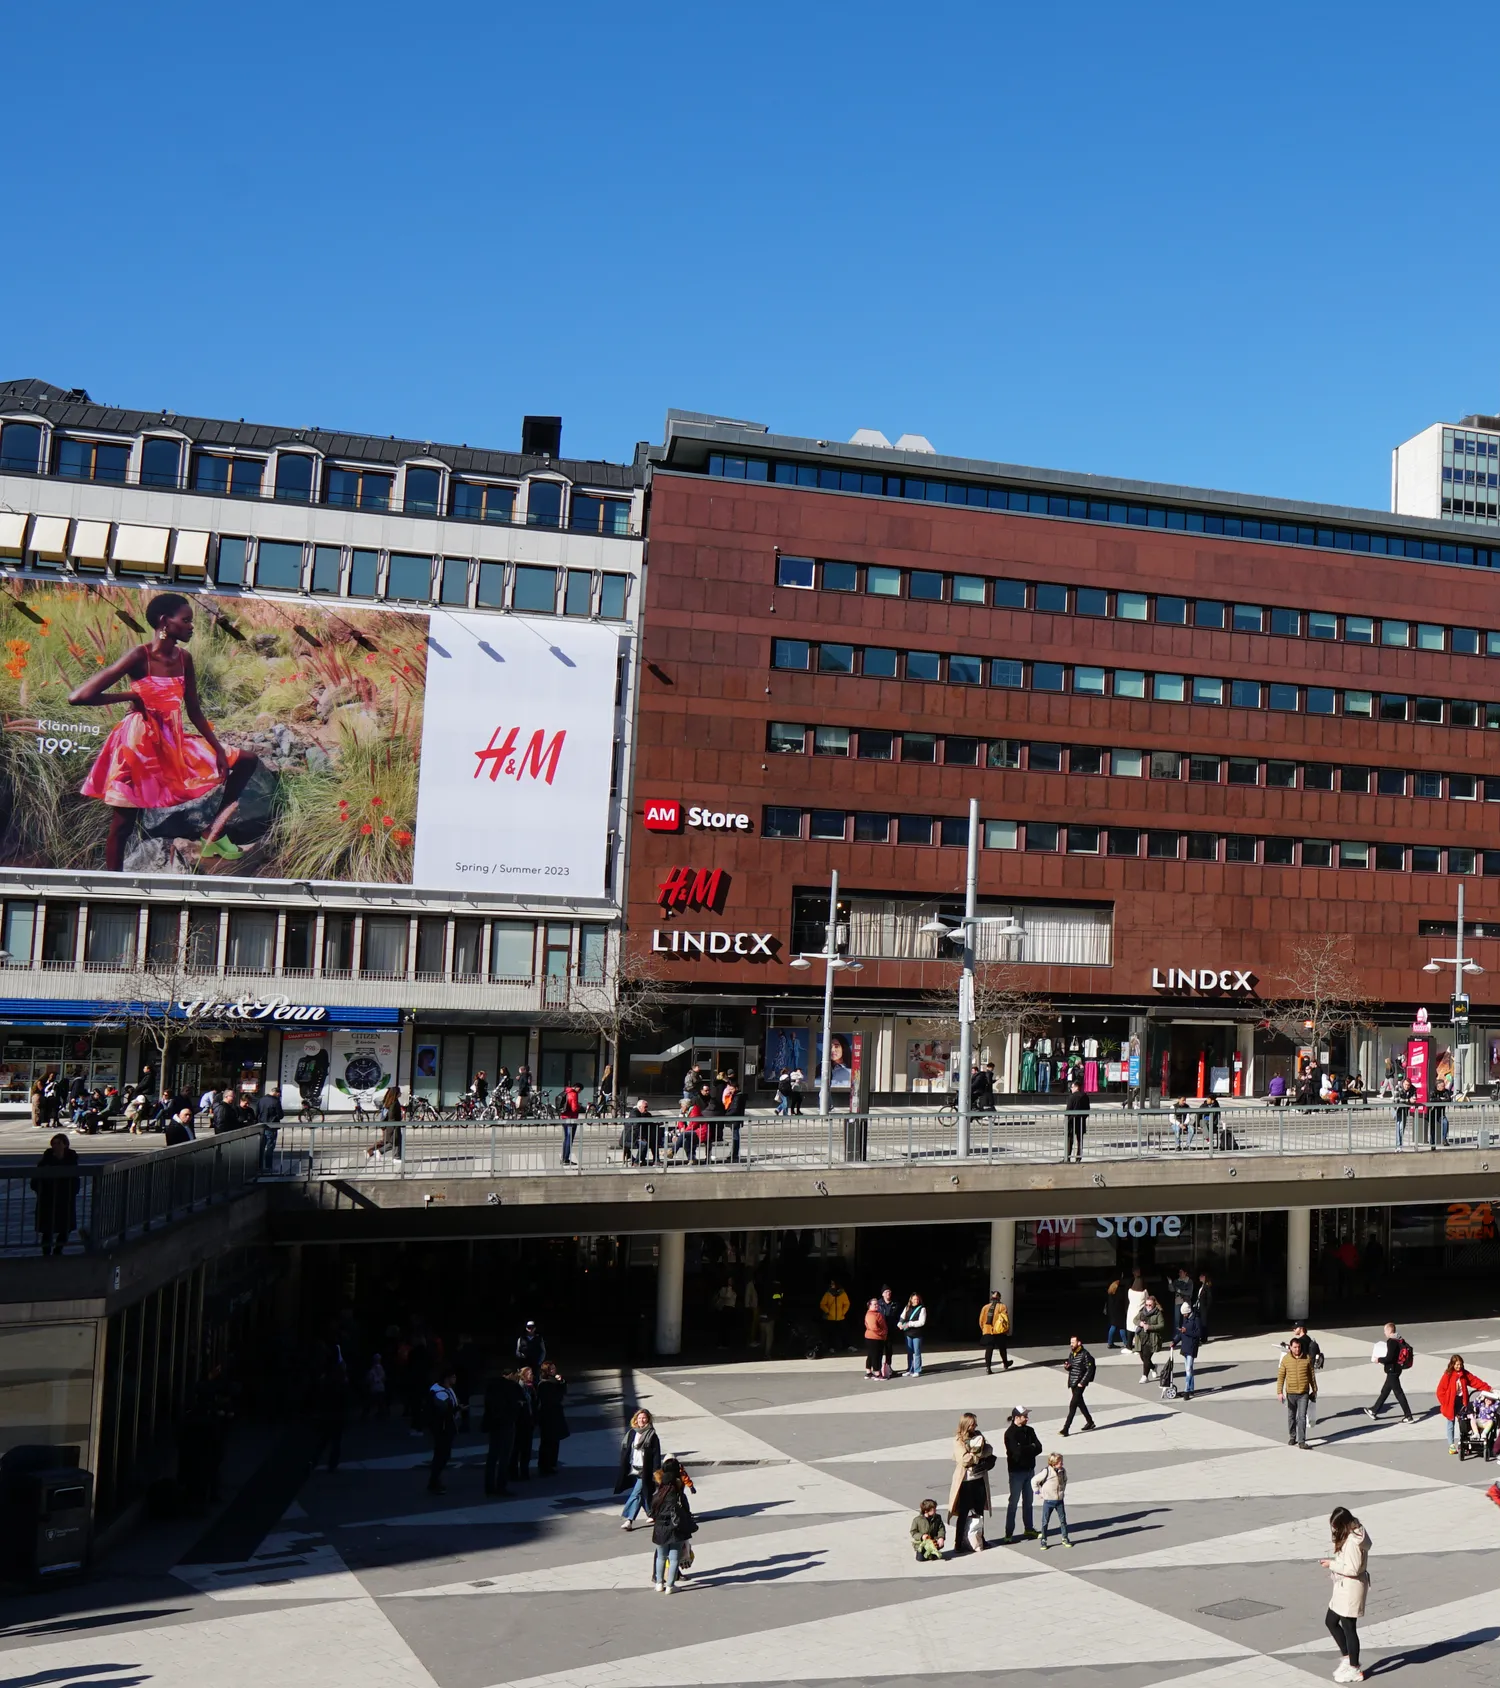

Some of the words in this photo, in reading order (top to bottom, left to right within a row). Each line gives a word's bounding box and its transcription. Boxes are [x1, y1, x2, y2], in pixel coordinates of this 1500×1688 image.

[38, 720, 100, 736] Klänning
[474, 726, 567, 786] H&M
[647, 807, 675, 821] AM
[688, 807, 749, 829] Store
[455, 862, 489, 874] Spring
[500, 864, 541, 875] Summer
[544, 866, 570, 876] 2023
[657, 866, 722, 908] H&M
[652, 929, 773, 955] LINDEX
[1152, 967, 1253, 991] LINDEX
[1446, 1203, 1495, 1226] 24
[1037, 1217, 1076, 1234] AM
[1096, 1215, 1181, 1239] Store
[1446, 1226, 1494, 1240] SEVEN
